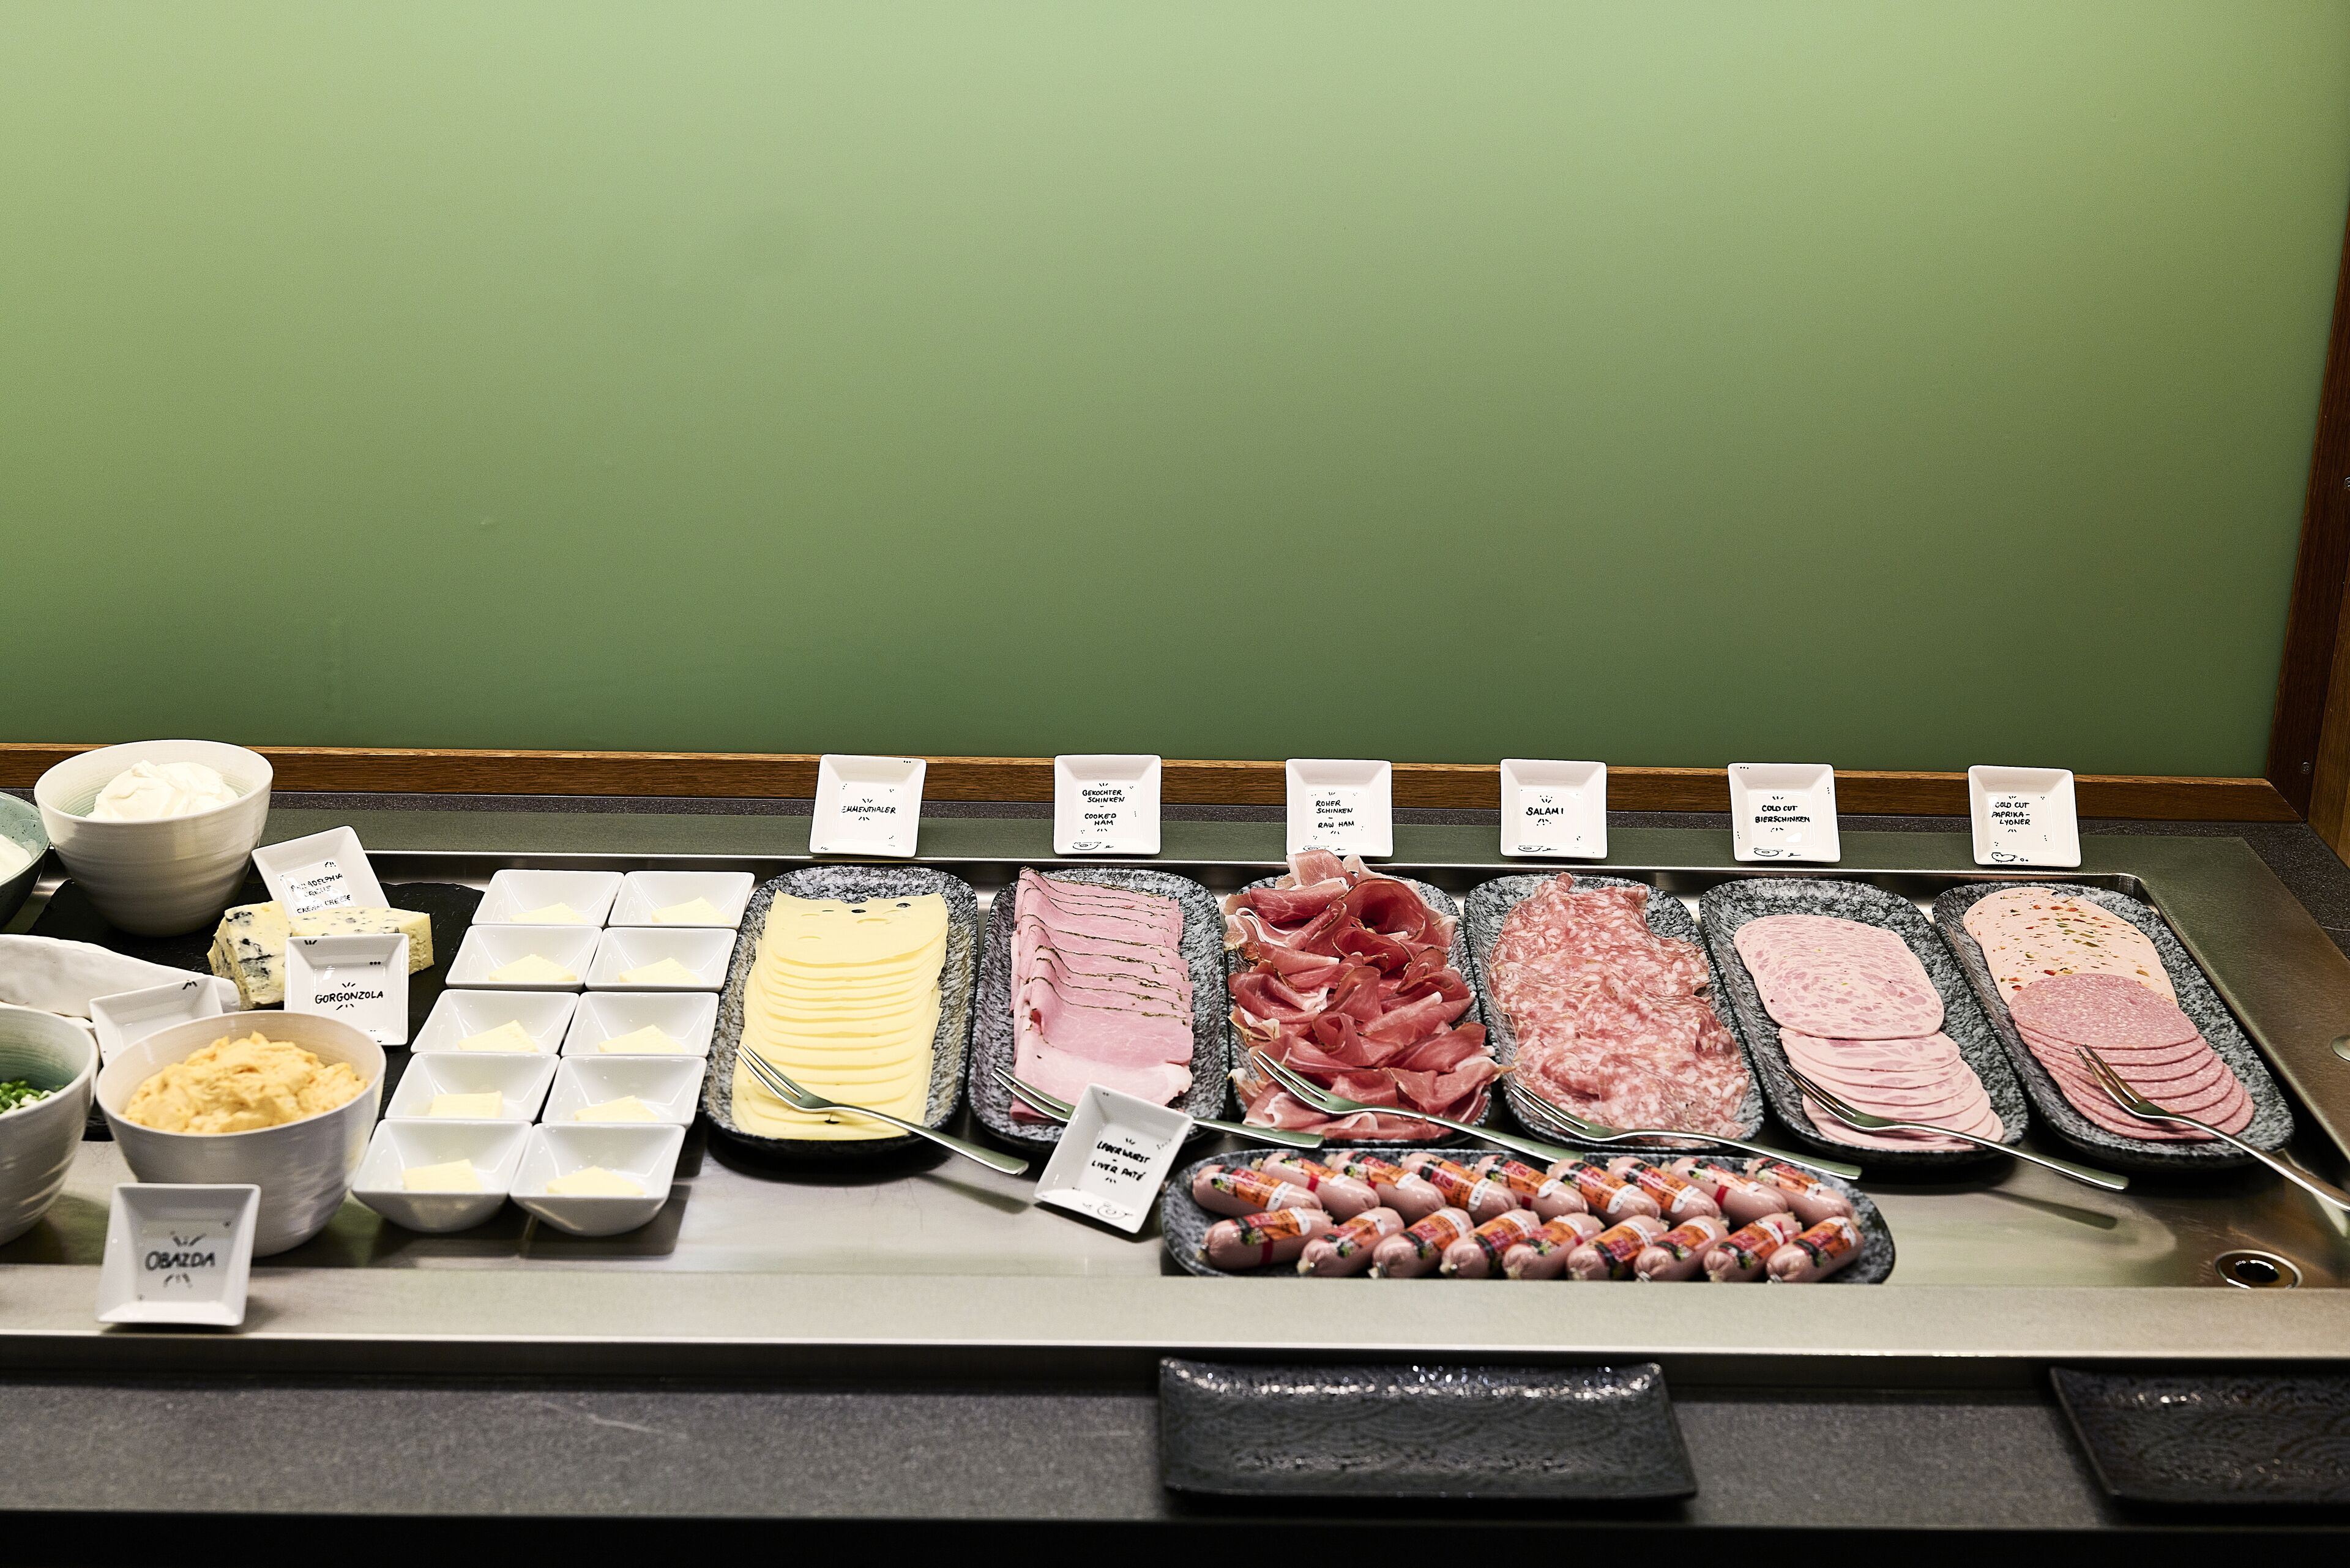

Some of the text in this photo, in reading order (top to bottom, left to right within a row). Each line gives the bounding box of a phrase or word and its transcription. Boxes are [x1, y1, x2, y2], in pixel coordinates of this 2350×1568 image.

[1526, 807, 1564, 816] SALAMI
[315, 990, 384, 1004] GORGONZOLA
[144, 1250, 216, 1271] OBAZDA
